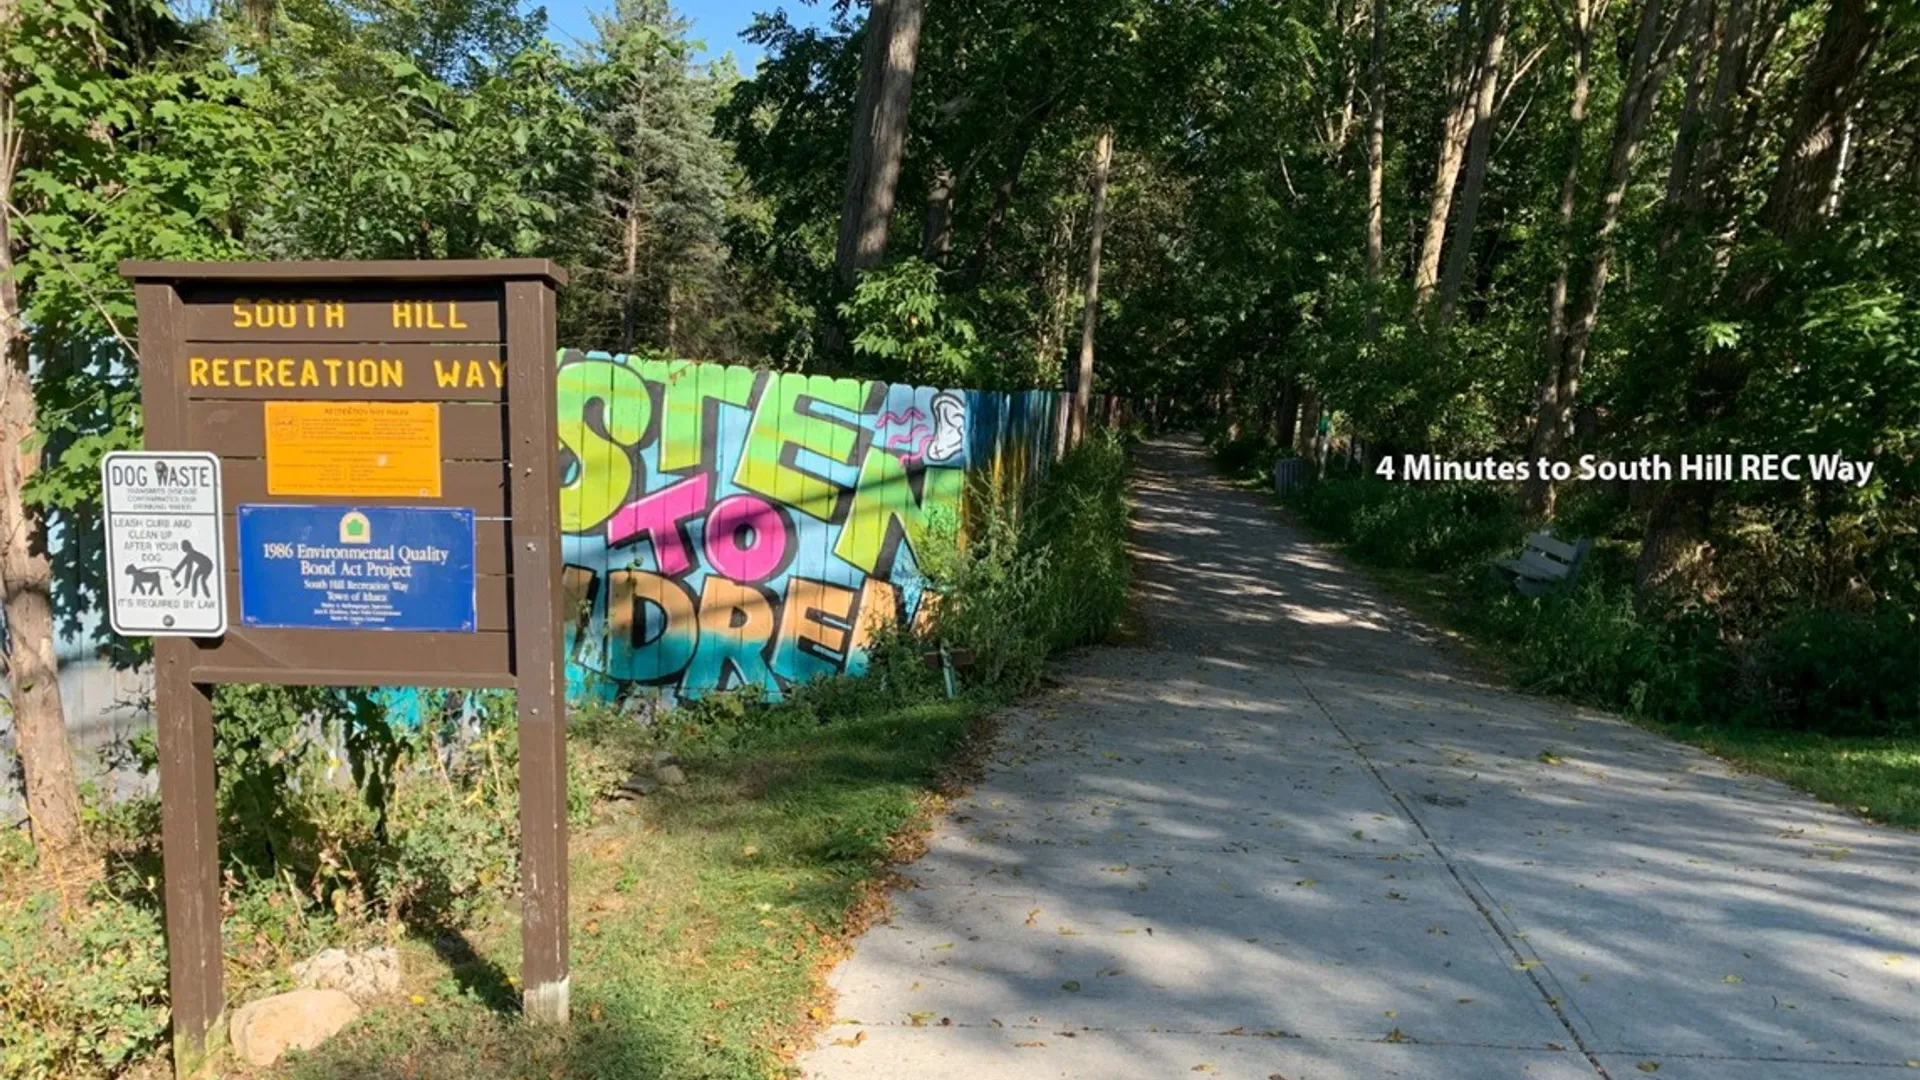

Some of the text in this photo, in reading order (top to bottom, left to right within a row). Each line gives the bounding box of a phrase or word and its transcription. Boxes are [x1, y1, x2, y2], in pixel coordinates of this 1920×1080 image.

[233, 299, 467, 328] SOUTH HILL
[189, 357, 507, 388] RECREATION WAY
[557, 358, 964, 578] STEN
[112, 466, 210, 487] DOG WASTE
[114, 519, 192, 528] LEASH CURB AND
[607, 472, 796, 583] TO
[128, 531, 172, 539] CLEAN UP
[124, 542, 178, 551] AFTER YOUR
[263, 543, 449, 565] 1986 Environmental Quality
[141, 553, 162, 562] DOG
[301, 560, 412, 580] Bond Act Project
[304, 580, 409, 593] South Hill Recreation Way
[136, 599, 180, 608] REQUIRED
[183, 600, 195, 608] BY
[197, 600, 216, 609] LAW
[326, 592, 350, 601] Town
[351, 592, 361, 601] of
